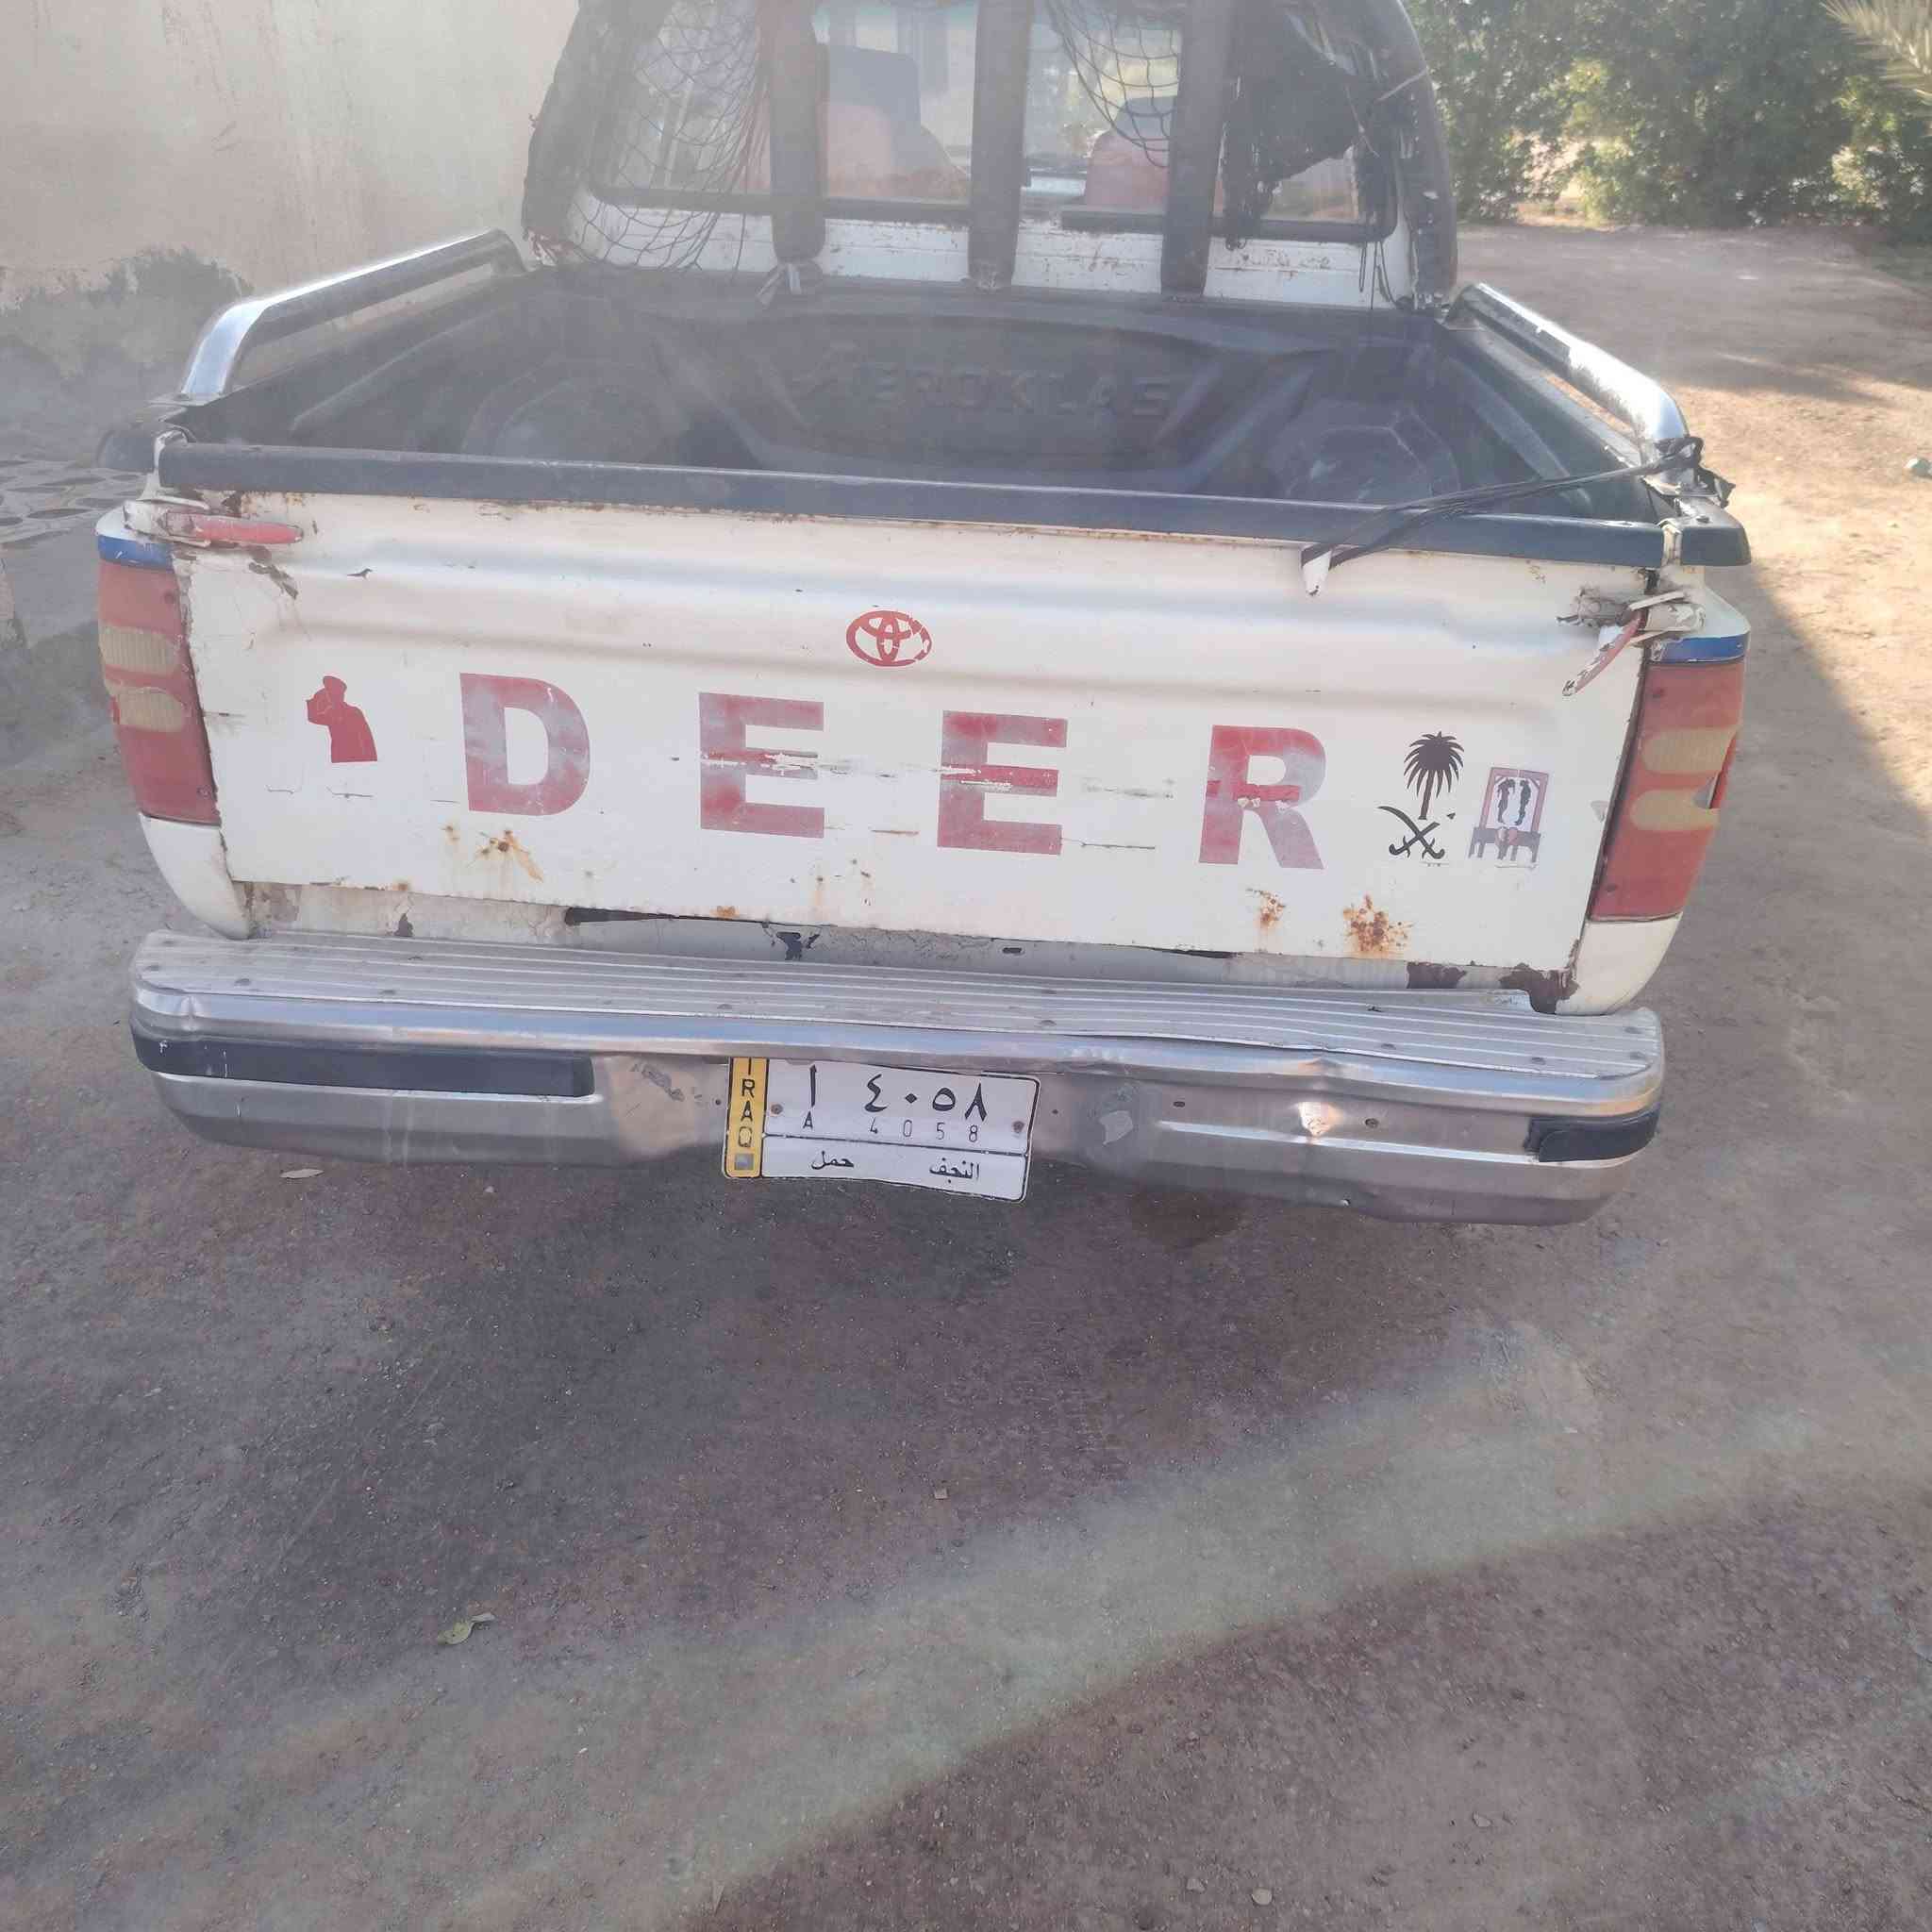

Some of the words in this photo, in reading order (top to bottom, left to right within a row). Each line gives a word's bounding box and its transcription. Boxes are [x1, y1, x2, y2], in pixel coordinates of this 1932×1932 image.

[459, 672, 1326, 870] DEER
[738, 1058, 756, 1148] IRAQ
[864, 1074, 988, 1122] ٤٠٥٨
[803, 1110, 813, 1129] A
[869, 1116, 978, 1143] 4058
[811, 1150, 855, 1170] حمل
[929, 1157, 980, 1184] النجف
